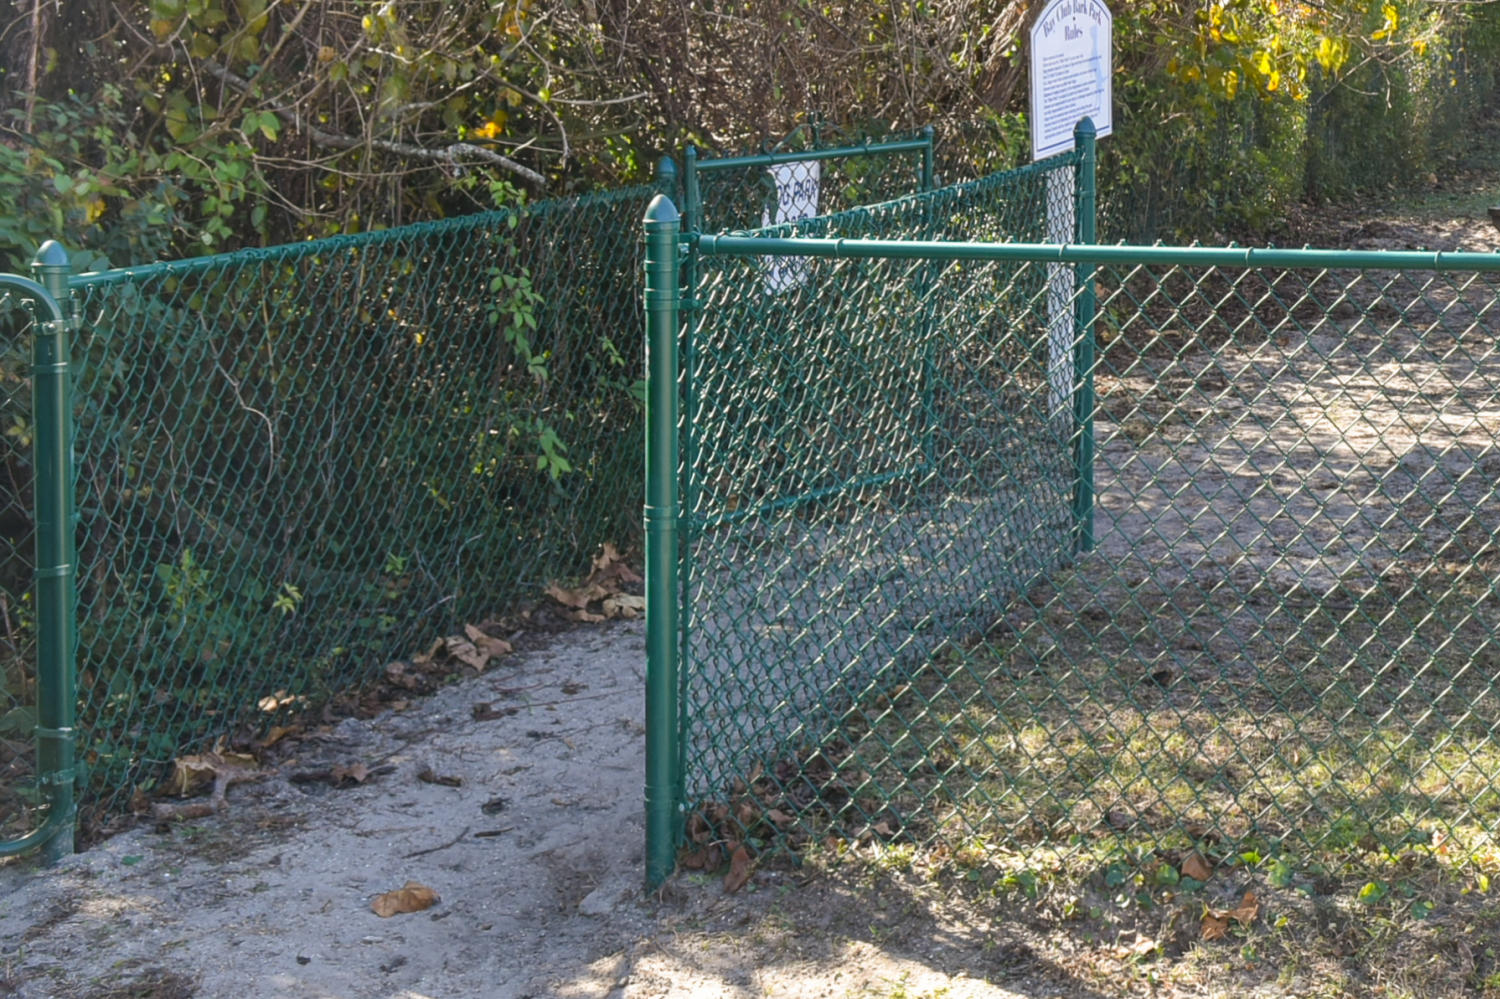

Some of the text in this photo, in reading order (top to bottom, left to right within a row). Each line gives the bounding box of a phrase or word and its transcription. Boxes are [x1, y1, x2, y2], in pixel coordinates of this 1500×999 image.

[1043, 18, 1056, 38] Bay
[1056, 0, 1072, 22] Club
[1089, 2, 1102, 26] Park
[1064, 24, 1083, 41] Rules
